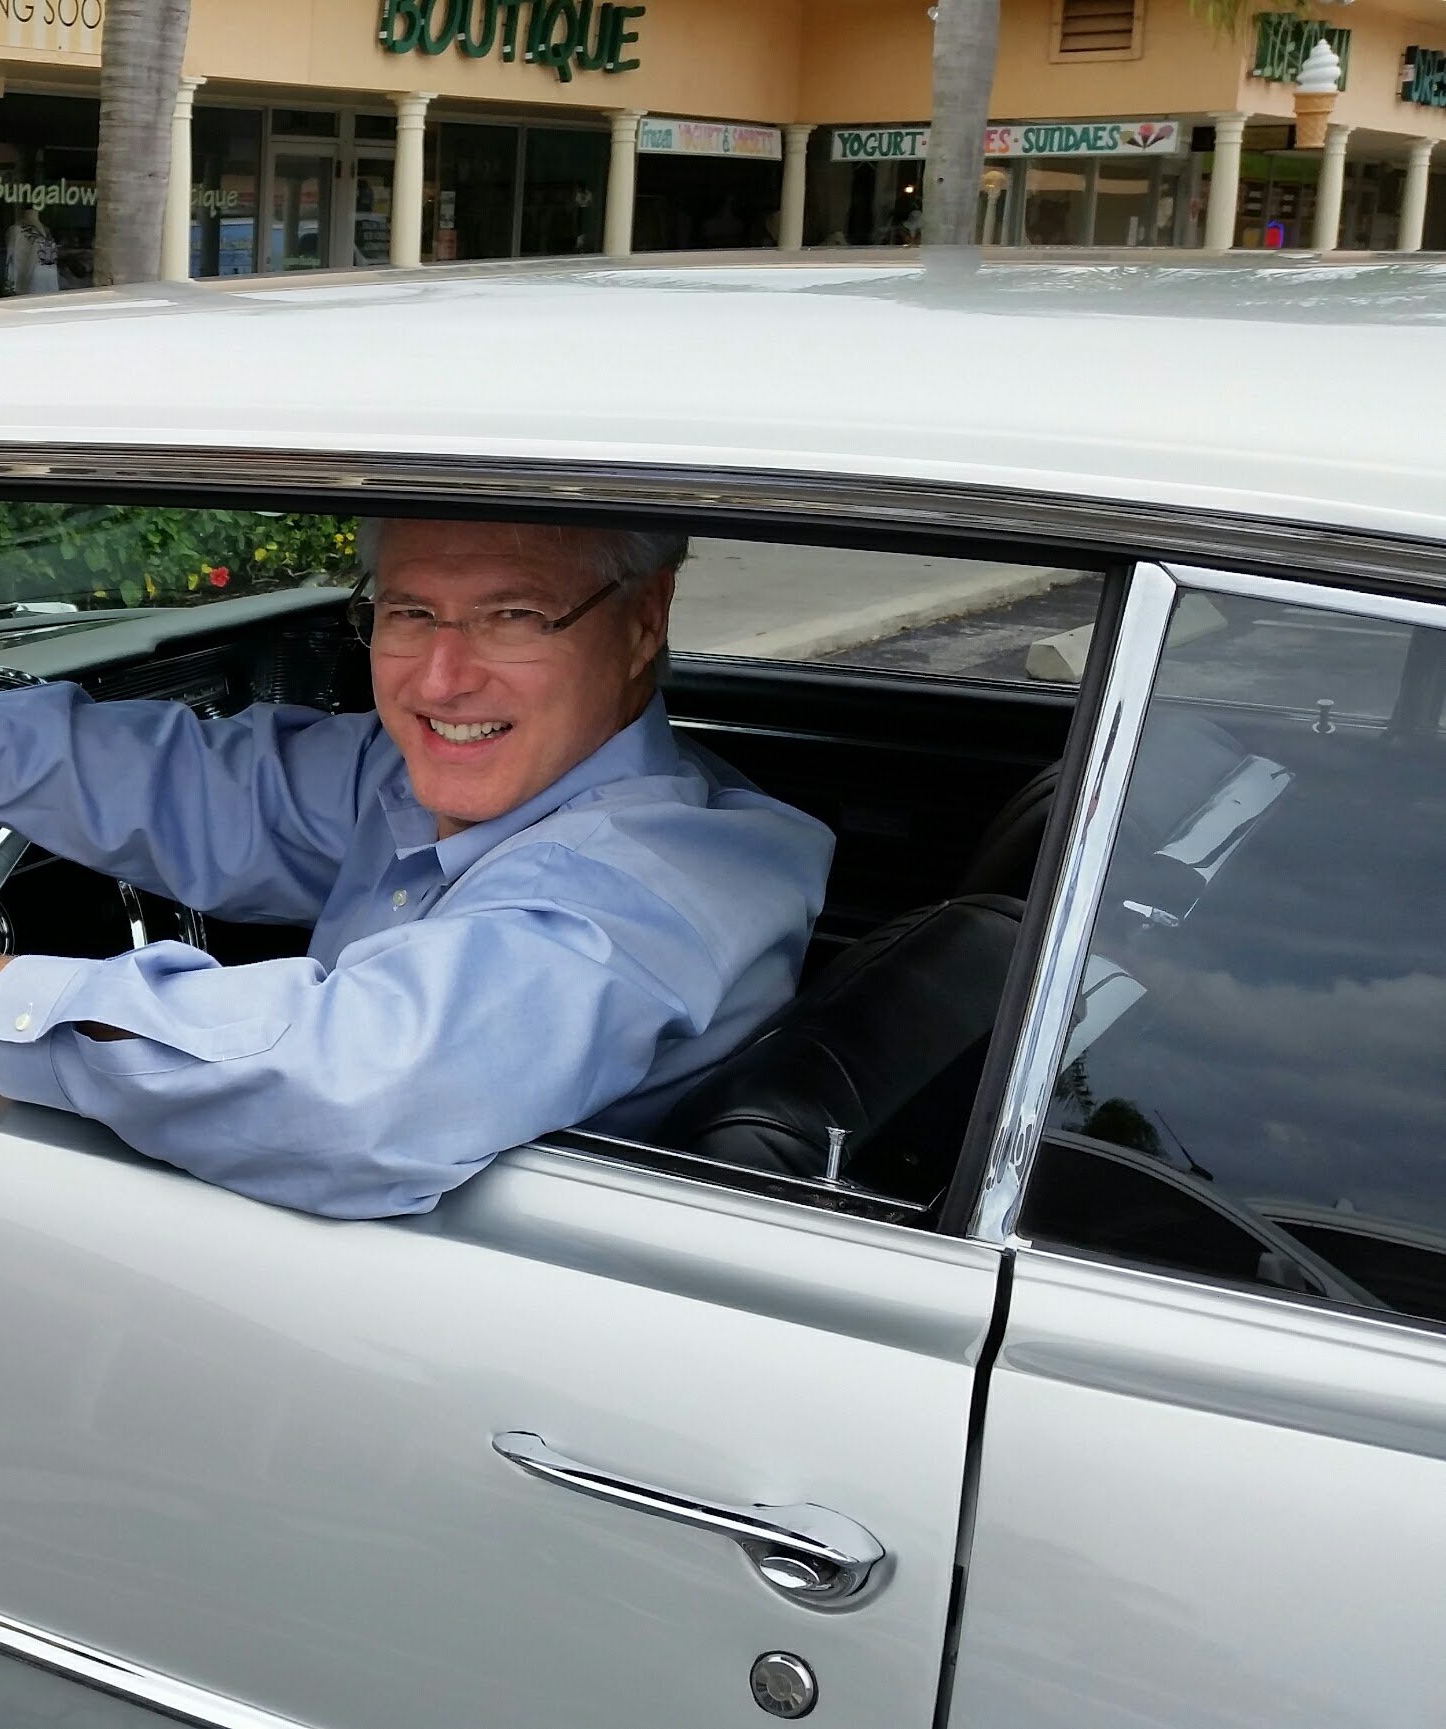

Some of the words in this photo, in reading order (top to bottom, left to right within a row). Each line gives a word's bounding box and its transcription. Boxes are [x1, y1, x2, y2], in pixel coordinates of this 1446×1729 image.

[379, 0, 645, 83] BOUTIQUE
[837, 131, 924, 158] YOGURT
[1022, 125, 1121, 153] SUNDAES
